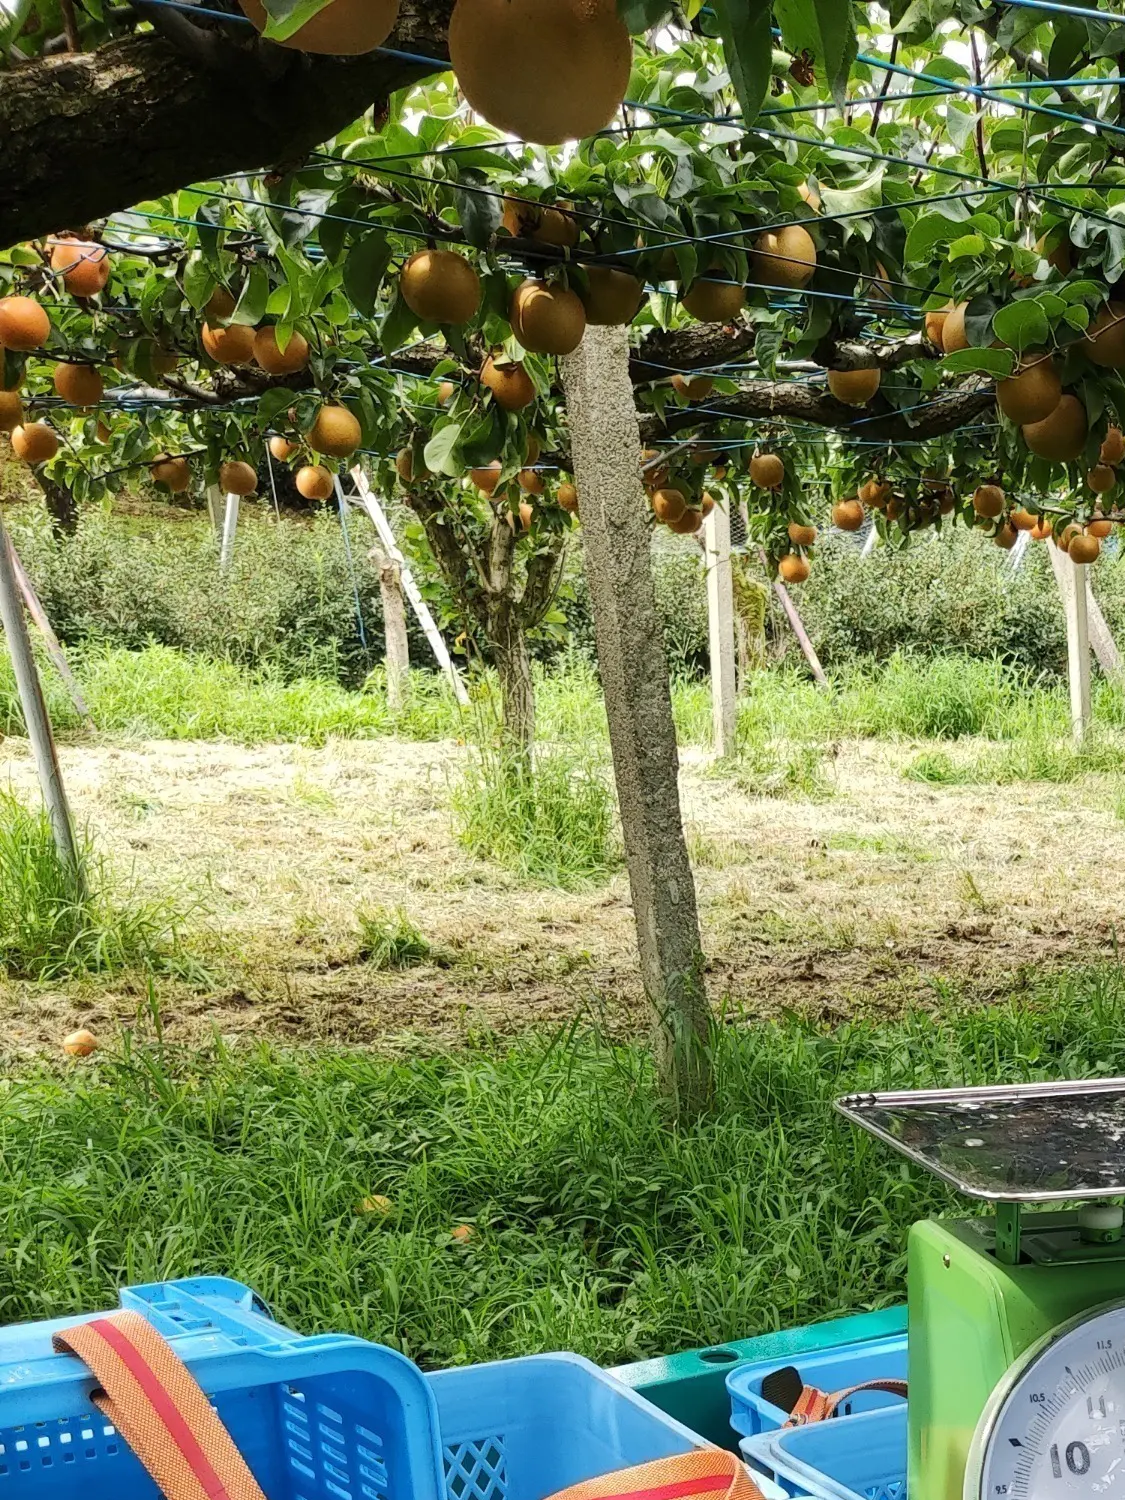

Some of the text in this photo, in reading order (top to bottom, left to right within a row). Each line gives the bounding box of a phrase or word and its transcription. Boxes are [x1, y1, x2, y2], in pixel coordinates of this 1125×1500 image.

[1096, 1340, 1113, 1350] 11.5
[1029, 1393, 1046, 1403] 10.5
[1050, 1440, 1091, 1478] 10
[995, 1485, 1007, 1494] 9.5
